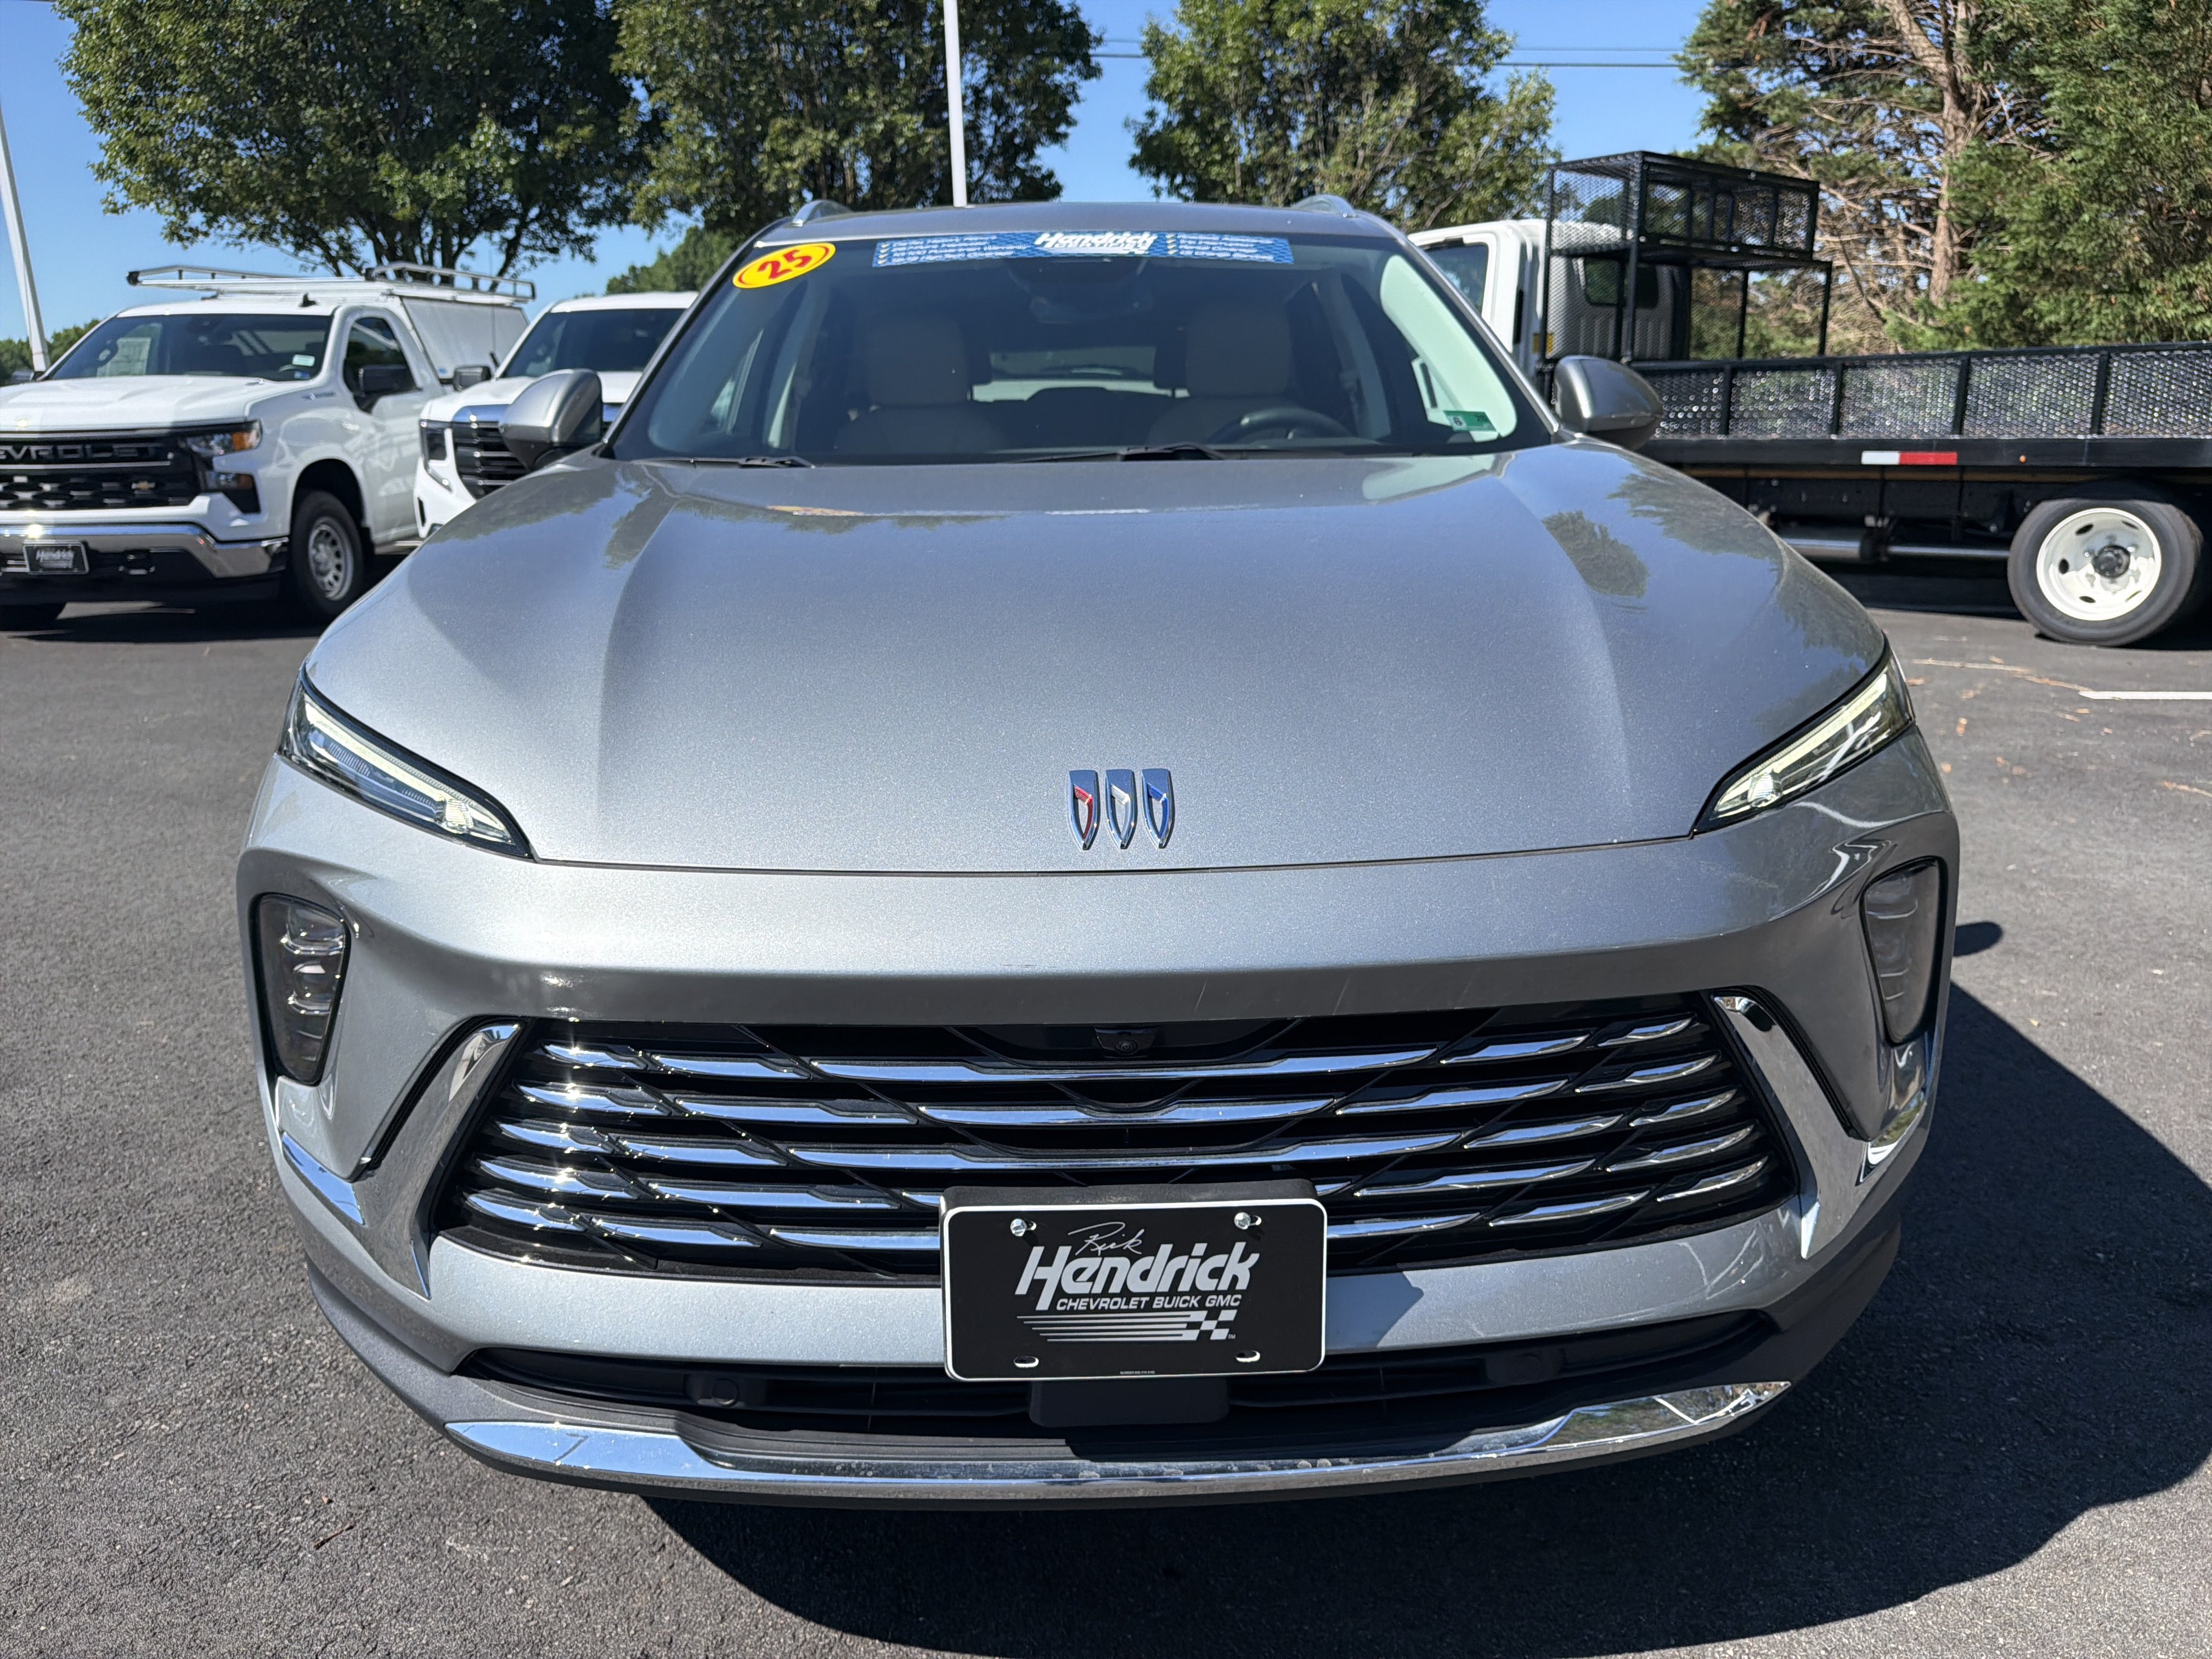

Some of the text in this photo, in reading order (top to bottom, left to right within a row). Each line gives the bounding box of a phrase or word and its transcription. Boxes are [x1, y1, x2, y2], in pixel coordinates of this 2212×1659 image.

[758, 249, 812, 279] 25
[1015, 1242, 1261, 1311] Hendrick
[1056, 1294, 1242, 1311] CHEVROLET BUICK GMC
